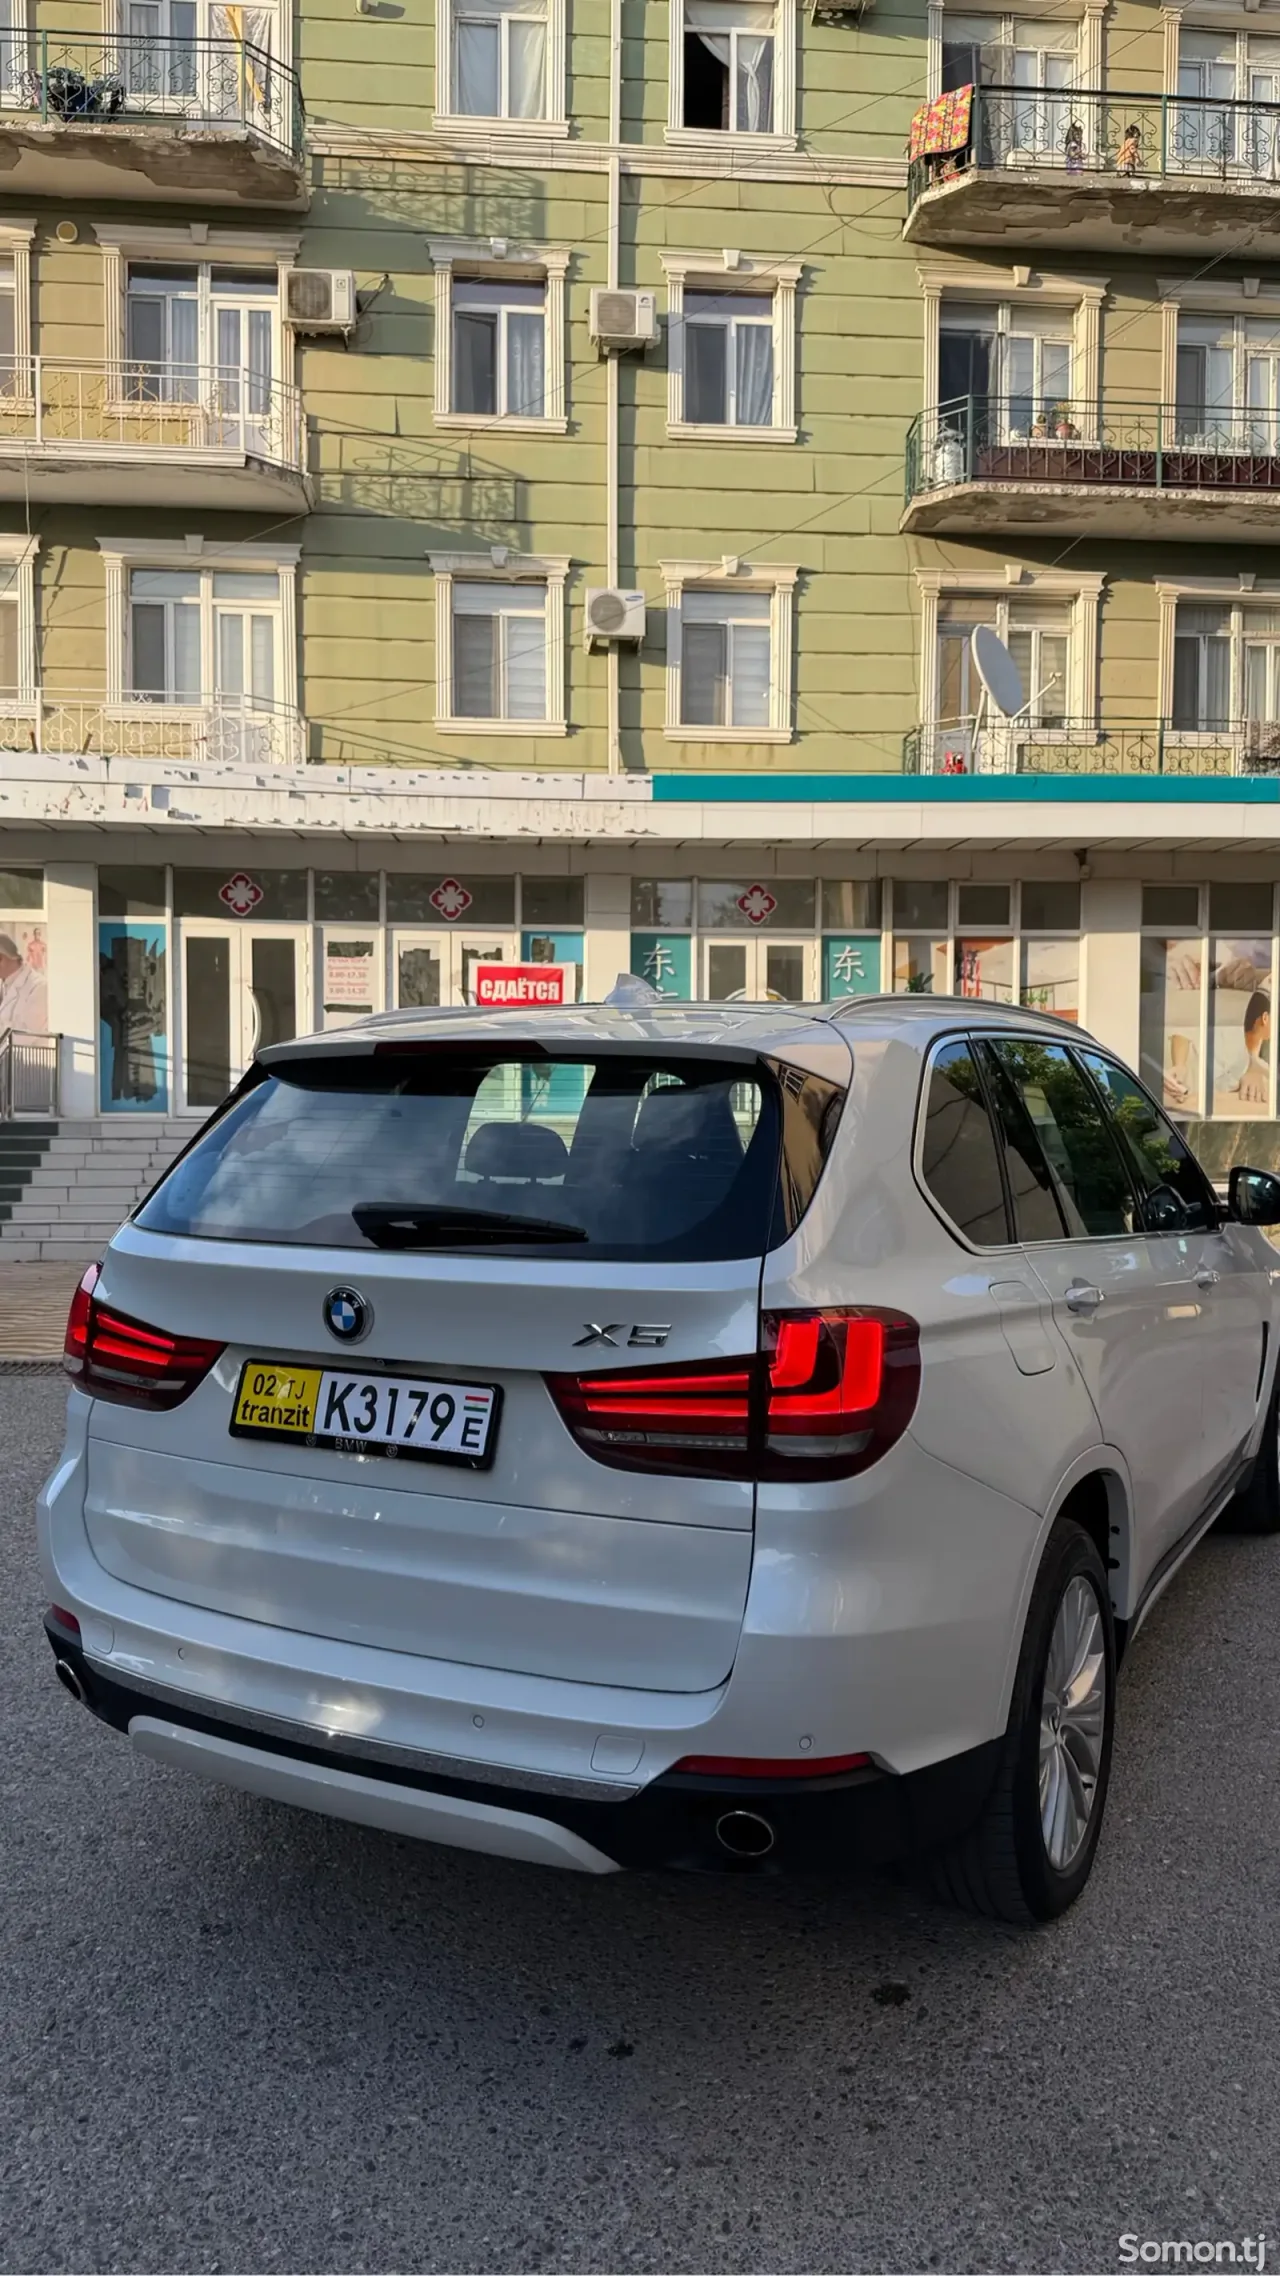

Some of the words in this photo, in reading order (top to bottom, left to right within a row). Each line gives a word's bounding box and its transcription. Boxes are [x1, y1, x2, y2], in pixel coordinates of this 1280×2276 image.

[480, 976, 560, 1002] СДАЁТСЯ
[572, 1323, 672, 1348] X5
[253, 1373, 277, 1397] 02
[287, 1379, 306, 1400] TJ
[241, 1399, 310, 1428] tranzit
[323, 1380, 456, 1442] K3179
[335, 1437, 368, 1454] BMW
[460, 1417, 484, 1449] E
